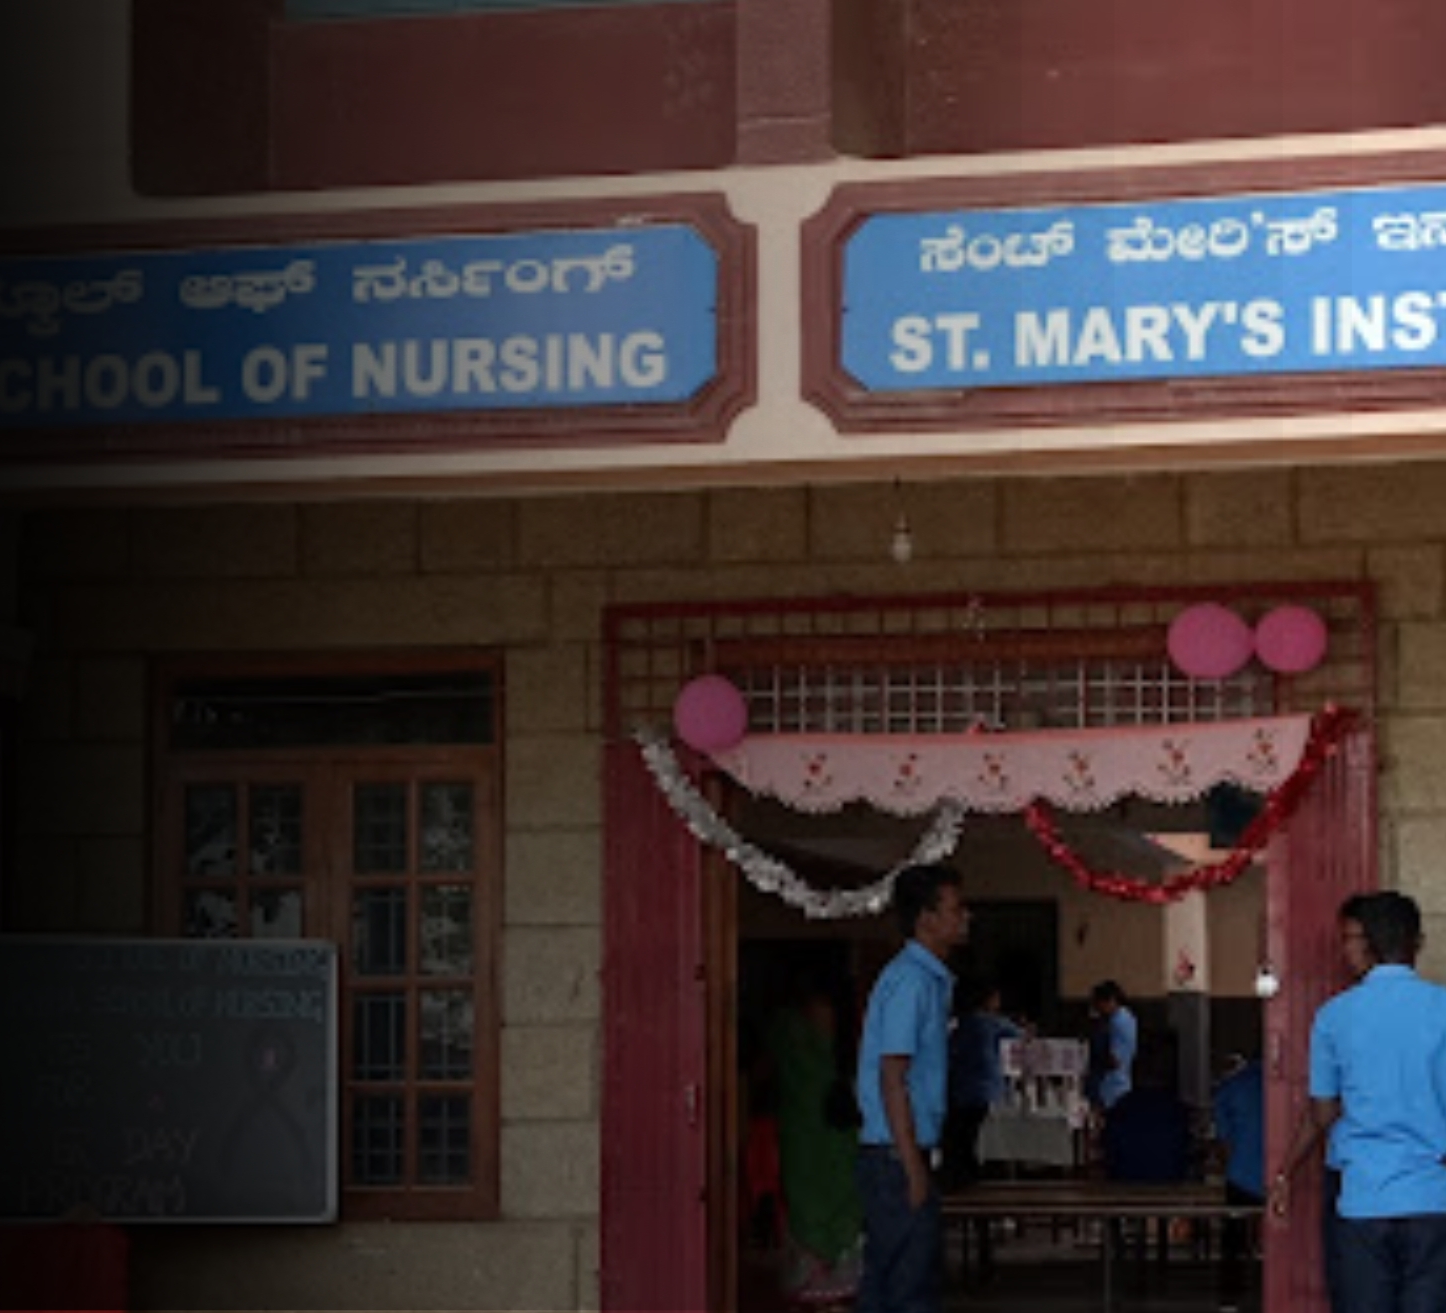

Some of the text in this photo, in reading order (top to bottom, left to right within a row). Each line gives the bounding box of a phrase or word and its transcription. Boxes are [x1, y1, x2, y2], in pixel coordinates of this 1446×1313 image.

[242, 344, 329, 404] OF
[353, 331, 667, 398] NURSING
[890, 312, 990, 373] ST.
[1014, 299, 1285, 368] MARY'S
